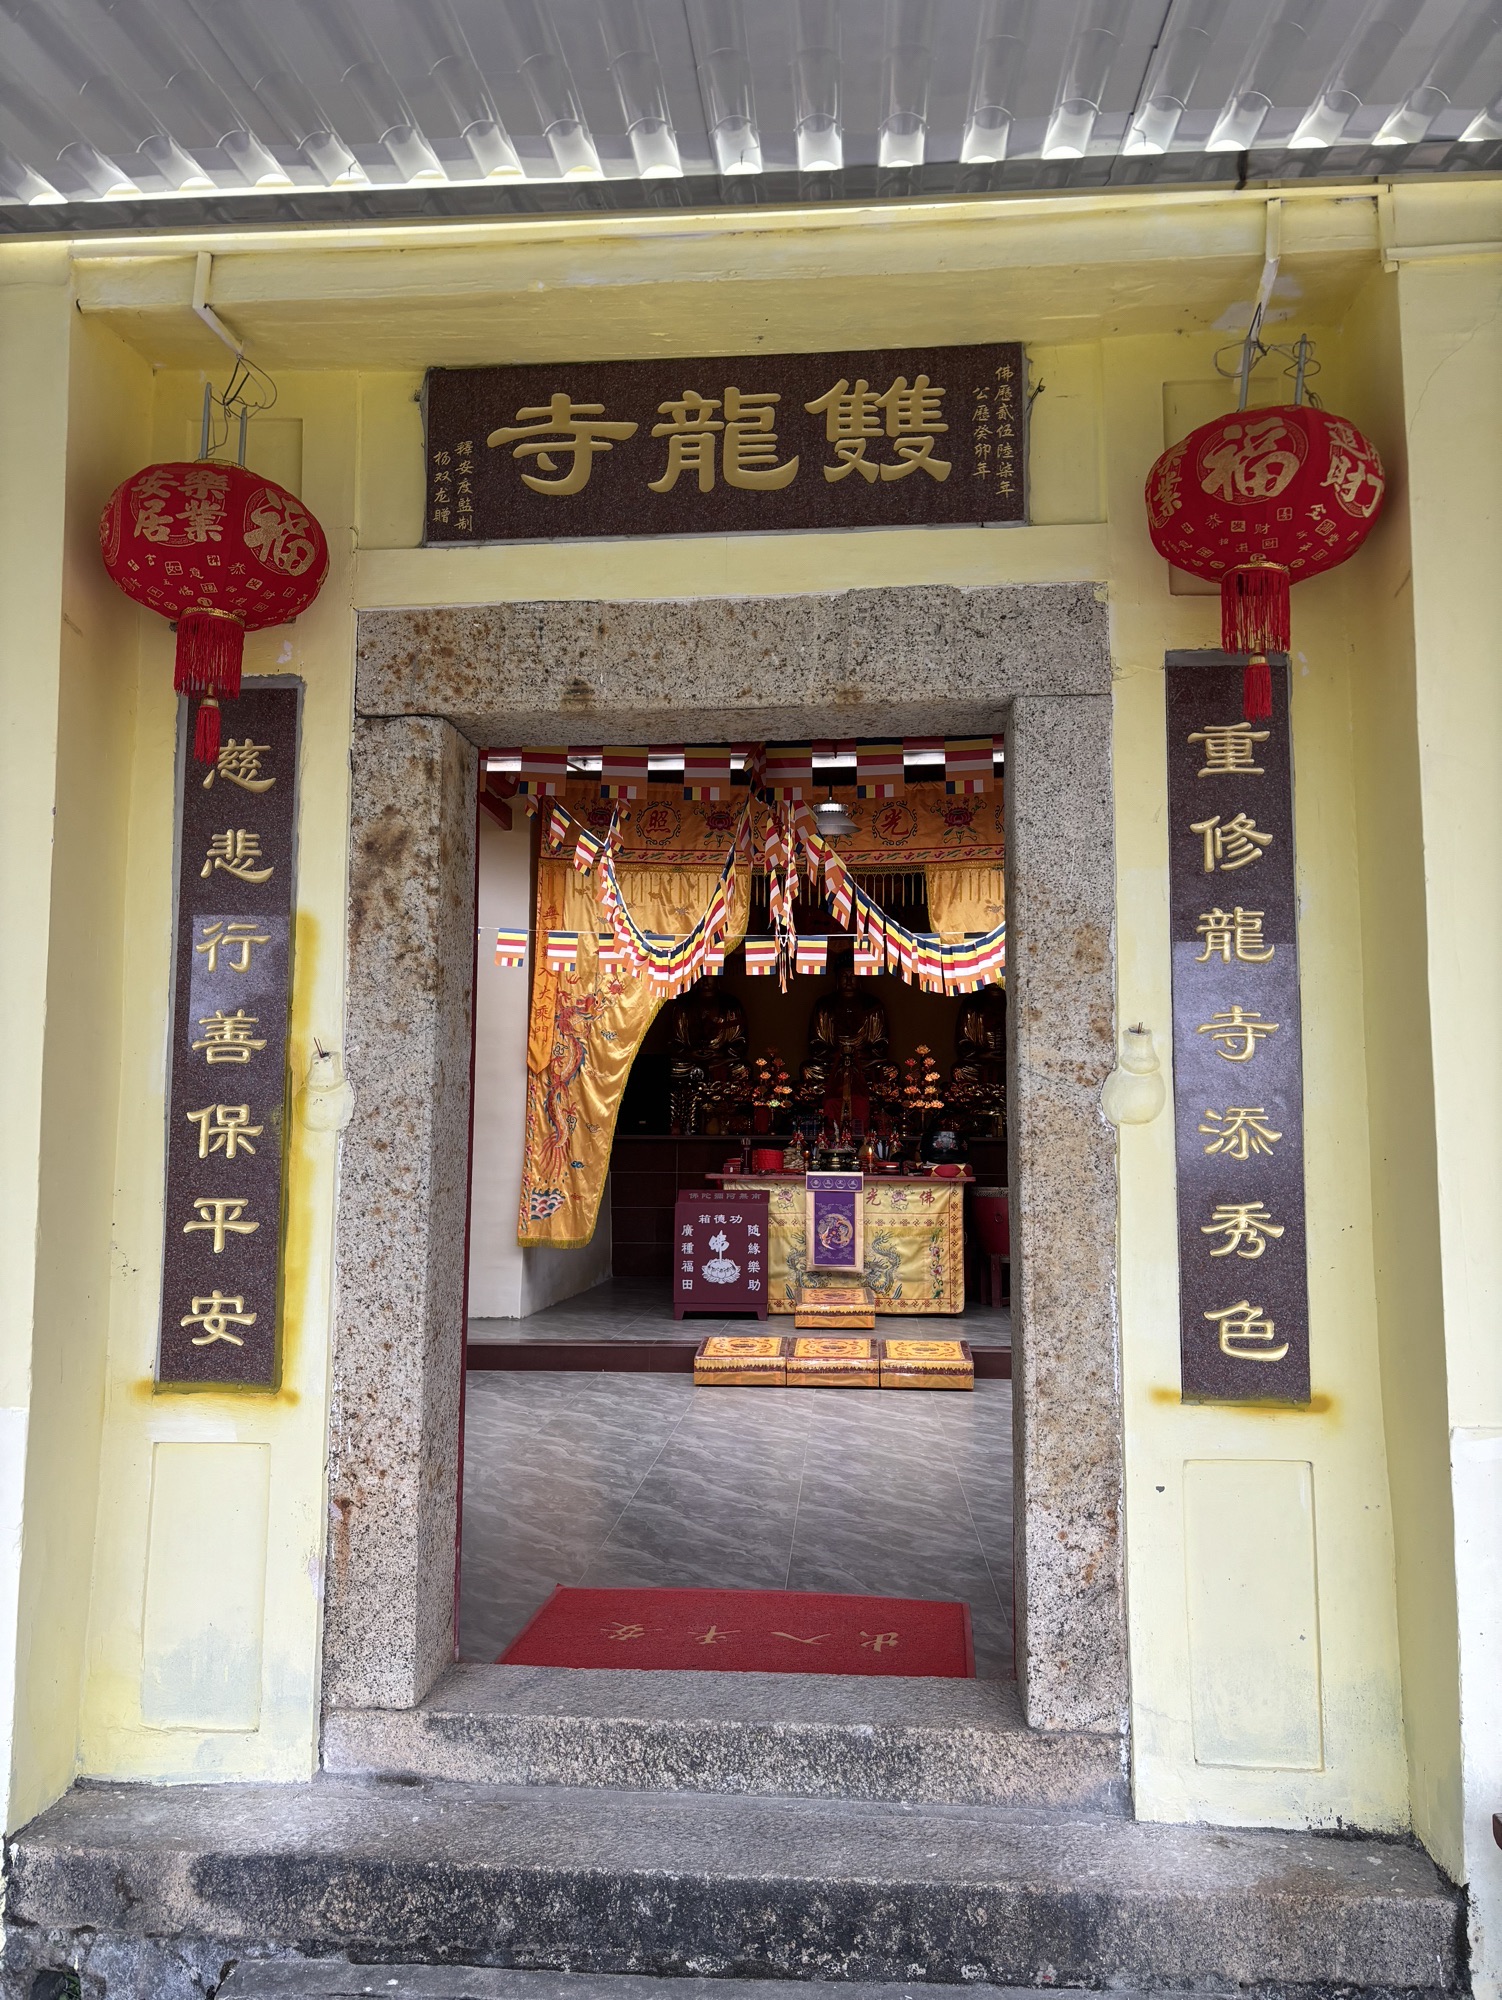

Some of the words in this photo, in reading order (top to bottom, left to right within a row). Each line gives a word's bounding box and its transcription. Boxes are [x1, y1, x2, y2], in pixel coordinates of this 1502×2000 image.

[486, 373, 953, 496] 雙龍寺
[1200, 416, 1300, 501] 福
[243, 487, 316, 577] 福
[179, 738, 277, 1348] 慈悲行善保平安
[1187, 721, 1290, 1361] 重修龍寺添秀色
